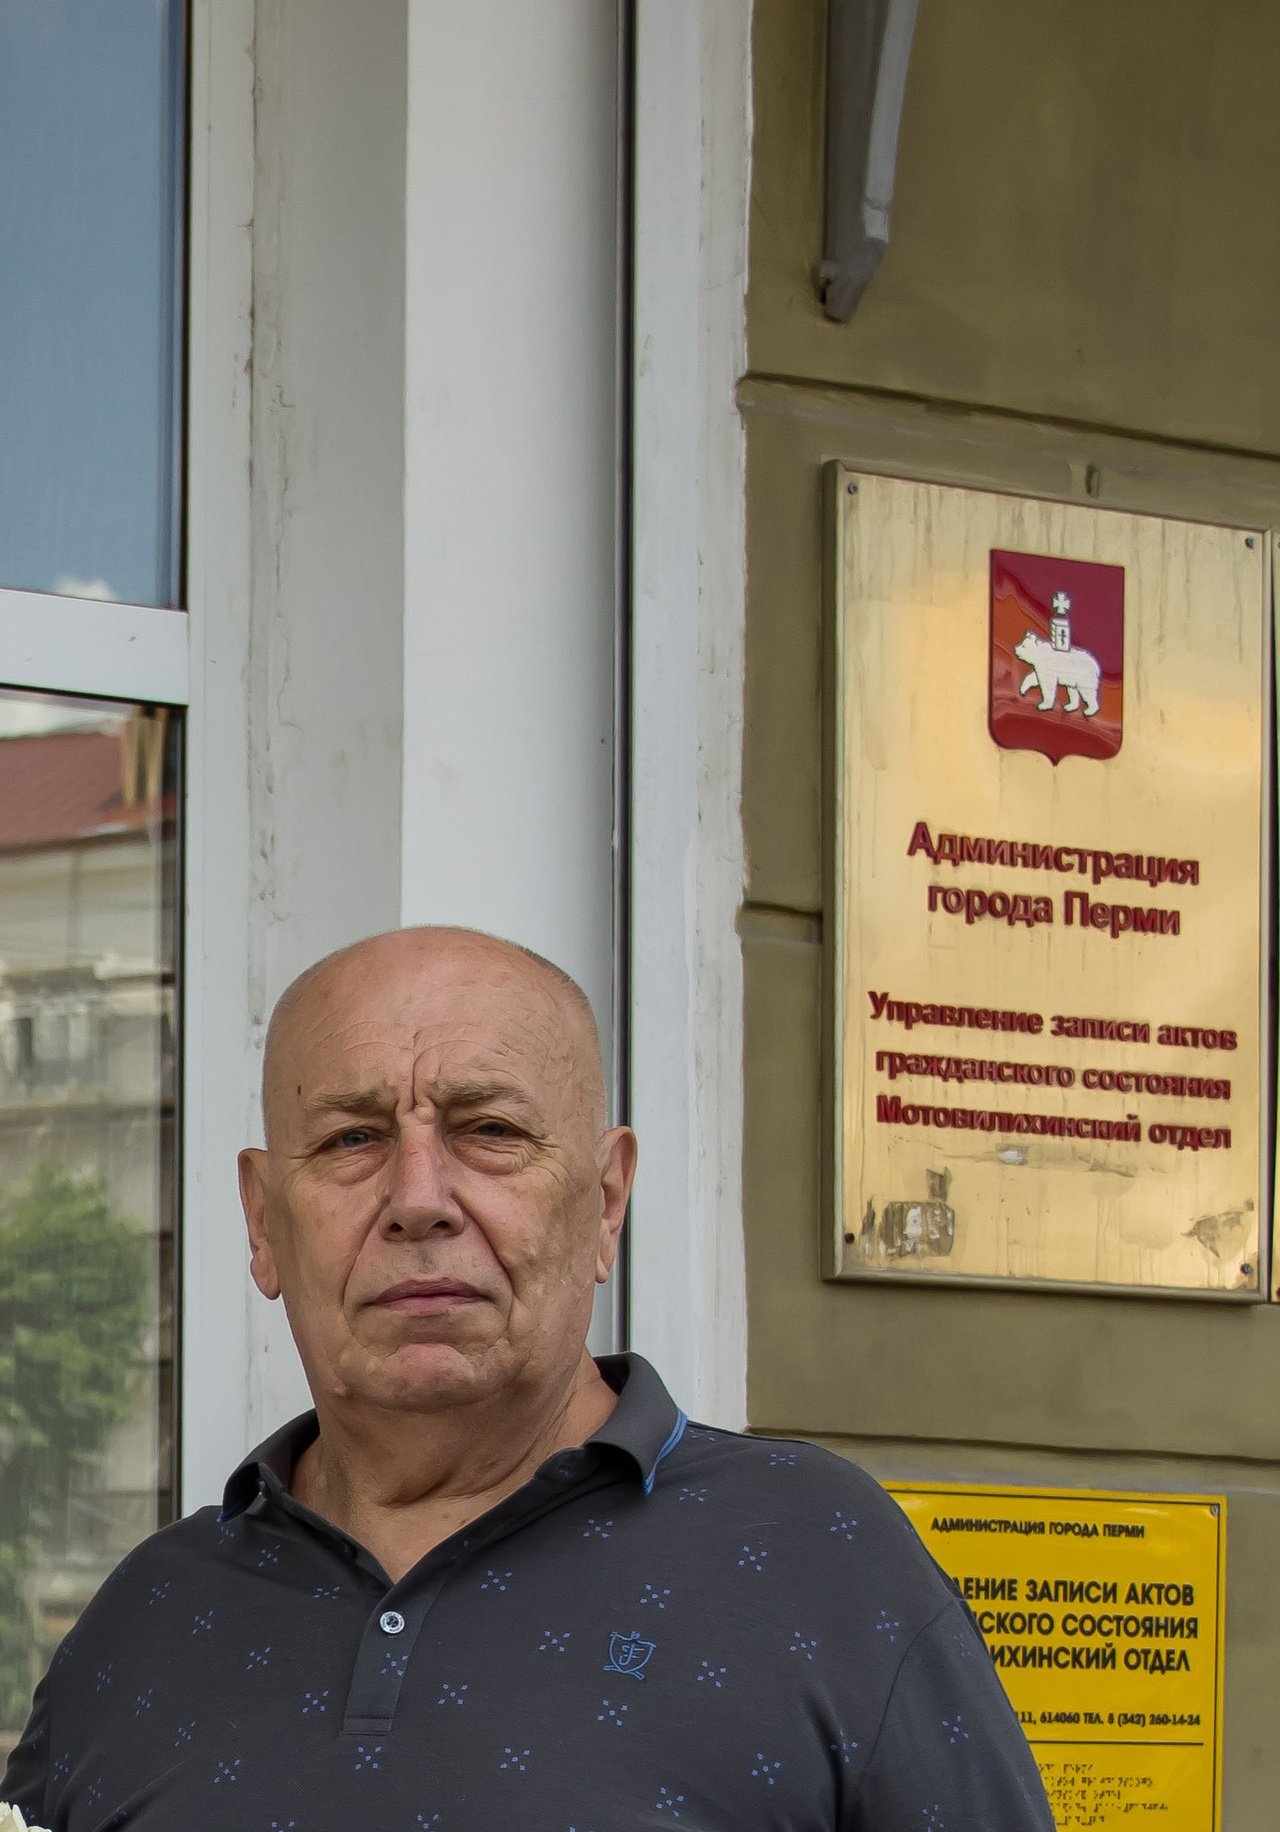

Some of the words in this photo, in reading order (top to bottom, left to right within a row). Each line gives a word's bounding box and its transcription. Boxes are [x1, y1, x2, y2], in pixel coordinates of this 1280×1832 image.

[907, 821, 1200, 887] Администрация
[927, 884, 1054, 926] города
[1064, 889, 1181, 939] Перми
[868, 990, 1044, 1035] Управление
[1050, 1013, 1150, 1044] записи
[1158, 1023, 1238, 1051] актов
[876, 1049, 1076, 1089] гражданского
[1082, 1068, 1231, 1101] состояния
[876, 1094, 1142, 1143] Мотовилихинский
[1148, 1122, 1232, 1152] отдел
[930, 1516, 1045, 1536] АДМИНИСТРАЦИЯ
[1048, 1520, 1099, 1539] ГОРОДА
[1102, 1523, 1145, 1539] ПЕРМИ
[953, 1576, 1019, 1601] ЕНИЕ
[1025, 1579, 1118, 1604] ЗАПИСИ
[1124, 1582, 1194, 1606] АКТОВ
[973, 1611, 1055, 1636] СКОГО
[1061, 1613, 1199, 1639] СОСТОЯНИЯ
[990, 1642, 1117, 1669] ИХИНСКИЙ
[1123, 1648, 1191, 1675] ОТДЕЛ
[1039, 1711, 1081, 1725] 614060
[1117, 1713, 1146, 1728] (342)
